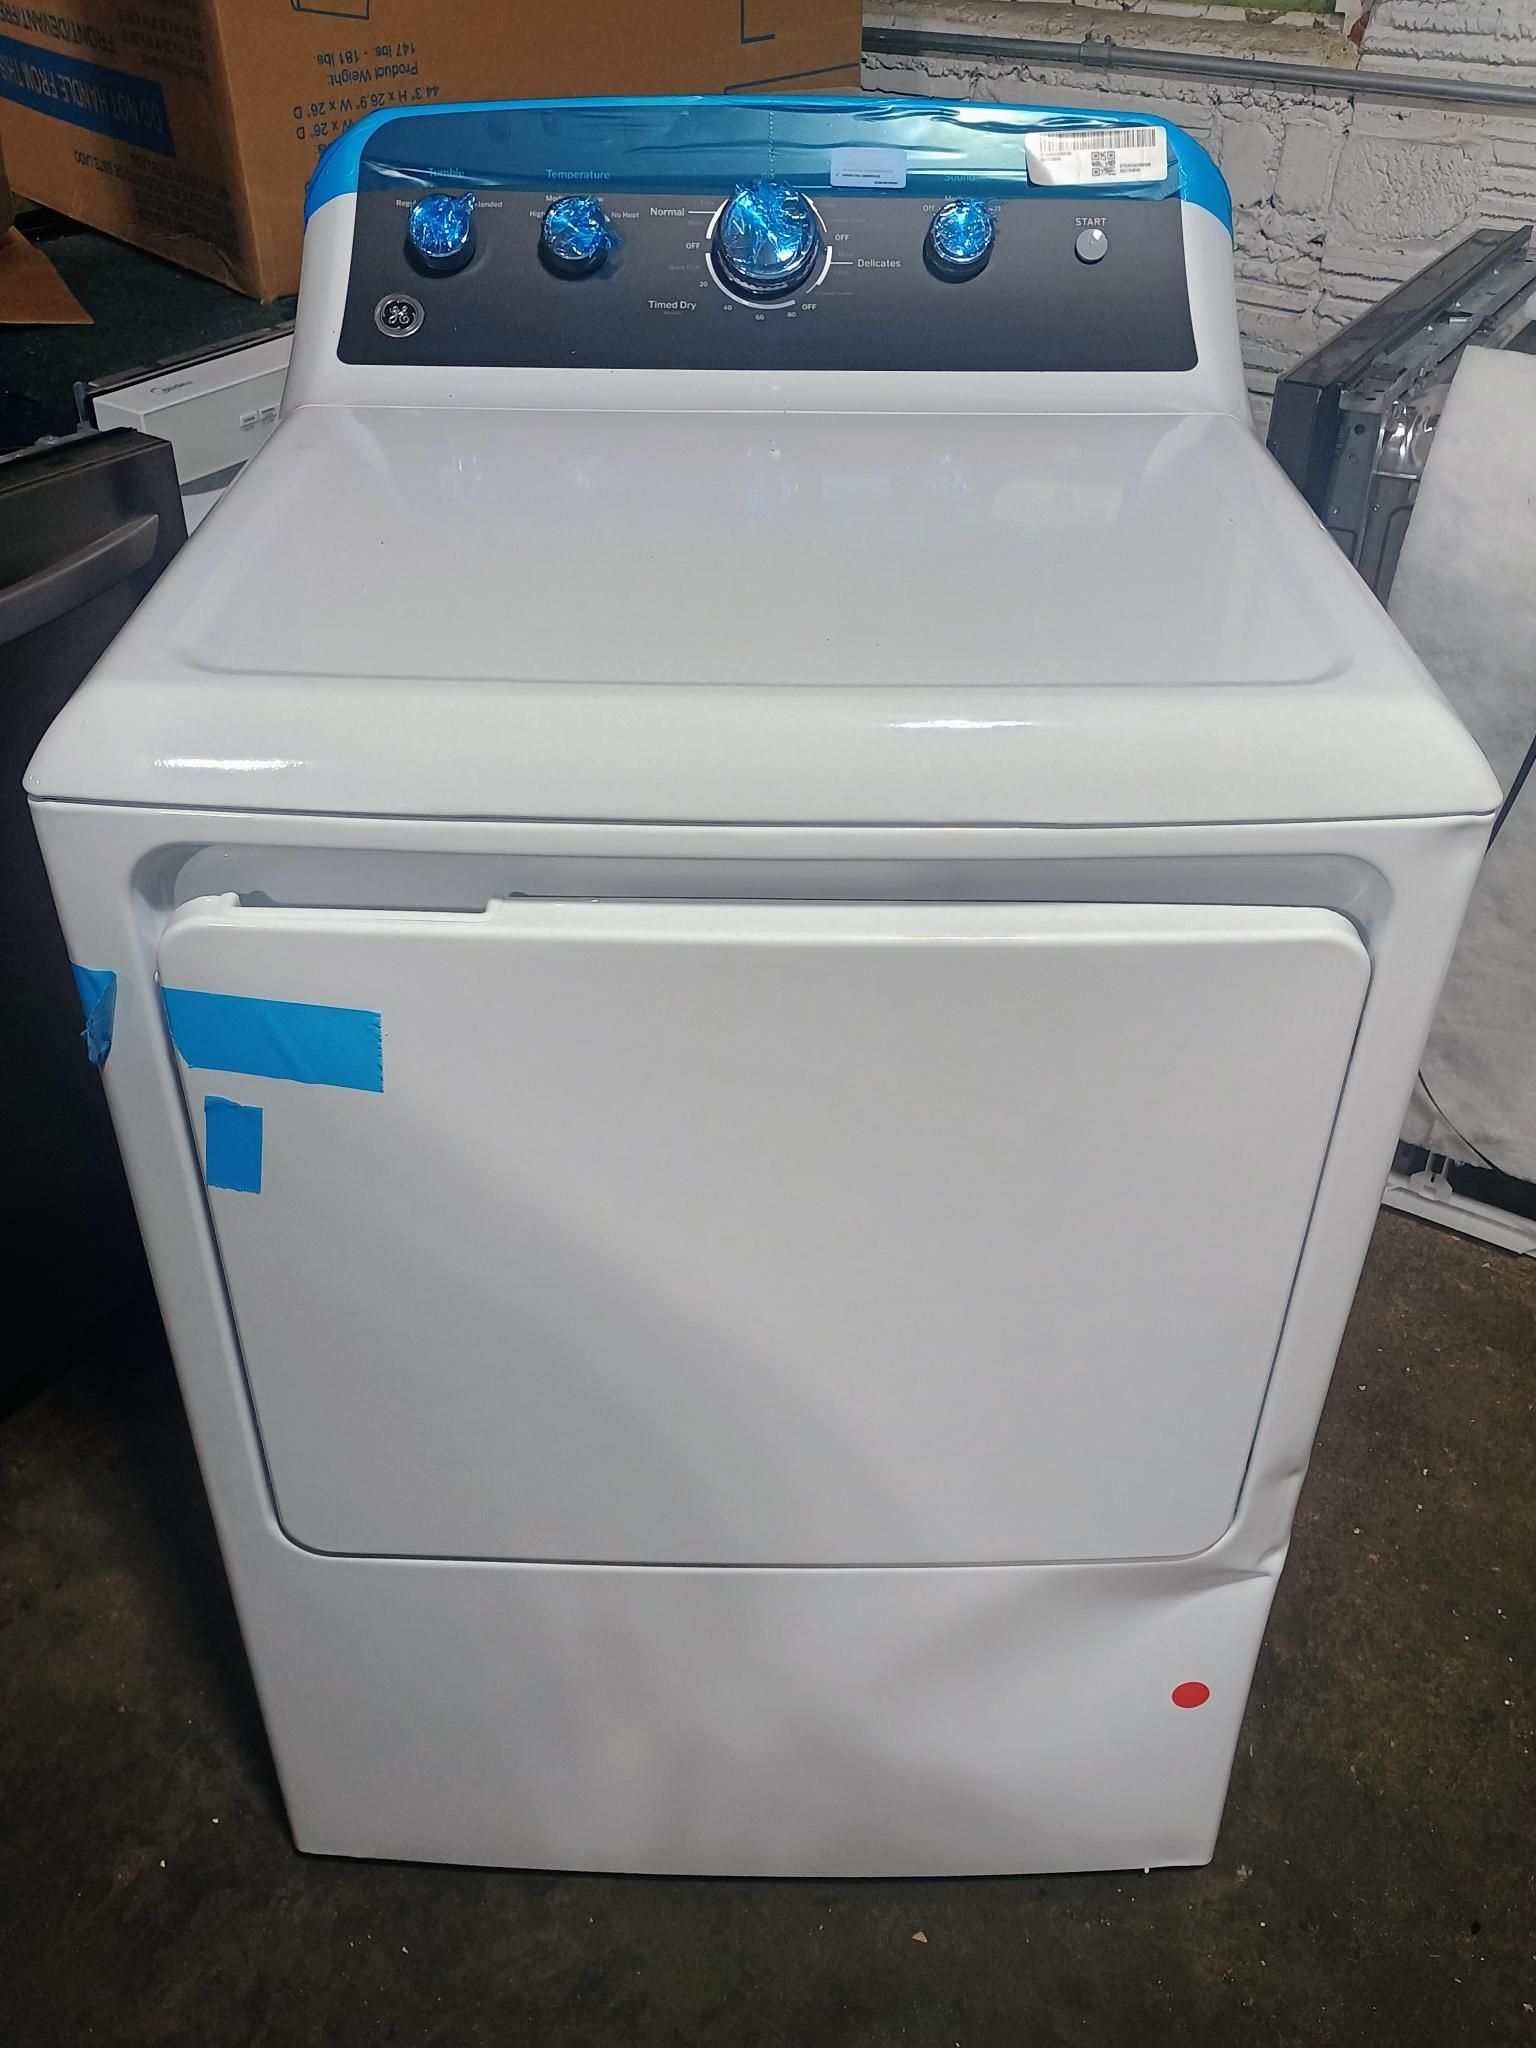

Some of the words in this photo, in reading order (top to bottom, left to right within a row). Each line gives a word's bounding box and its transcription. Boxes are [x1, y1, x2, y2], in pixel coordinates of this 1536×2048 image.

[396, 42, 416, 57] 147
[314, 53, 335, 67] lbs.
[340, 50, 360, 65] 181
[375, 62, 418, 79] Product
[24, 62, 59, 100] FROM
[327, 69, 372, 86] Weight:
[58, 74, 108, 118] HANDLE
[388, 91, 396, 101] x
[398, 90, 407, 101] H
[111, 90, 140, 126] NOT
[329, 100, 337, 110] x
[340, 98, 353, 112] W
[143, 102, 163, 133] DO
[293, 106, 303, 120] D
[332, 121, 338, 130] x
[296, 126, 305, 140] D
[428, 167, 465, 177] Tumble
[545, 168, 611, 180] Temperature
[650, 207, 685, 217] Normal
[922, 204, 934, 212] Off
[611, 211, 622, 219] No
[1075, 217, 1107, 227] START
[834, 234, 850, 242] OFF
[685, 242, 700, 250] OFF
[857, 258, 901, 268] Delicates
[648, 300, 678, 310] Timed
[680, 300, 697, 312] Dry
[723, 304, 733, 312] 40
[801, 303, 816, 311] OFF
